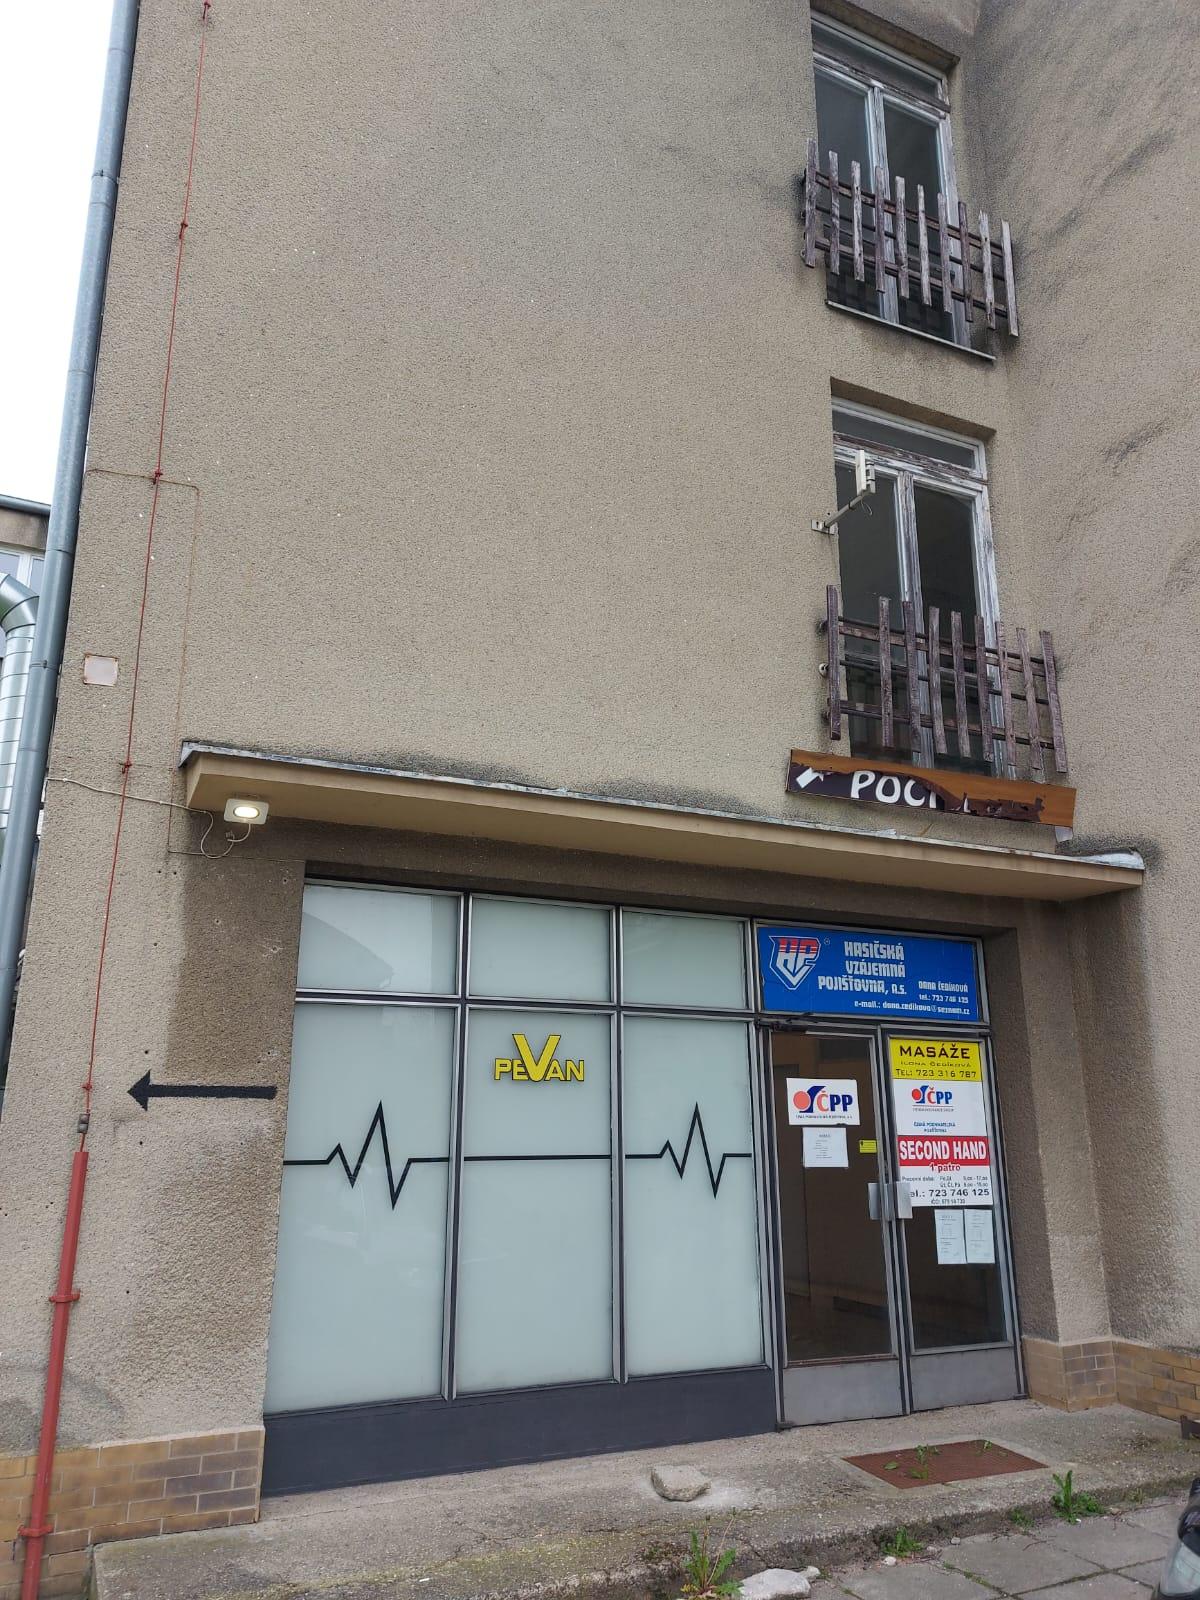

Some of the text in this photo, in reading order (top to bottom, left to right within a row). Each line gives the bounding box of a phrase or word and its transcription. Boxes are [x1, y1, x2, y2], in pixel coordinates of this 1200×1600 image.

[844, 940, 905, 960] HASIČSKÁ
[845, 959, 906, 978] VZÁJEMNÁ
[494, 1033, 585, 1082] PEVAN
[899, 1043, 971, 1059] MASÁŽE
[916, 1069, 935, 1077] 723
[937, 1069, 956, 1078] 316
[959, 1070, 977, 1078] 787
[816, 1090, 853, 1112] ČPP
[927, 1086, 953, 1105] ČPP
[899, 1140, 950, 1160] SECOND
[953, 1140, 987, 1160] HAND
[937, 1163, 961, 1173] patro
[909, 1188, 990, 1198] el.: 723 746 125
